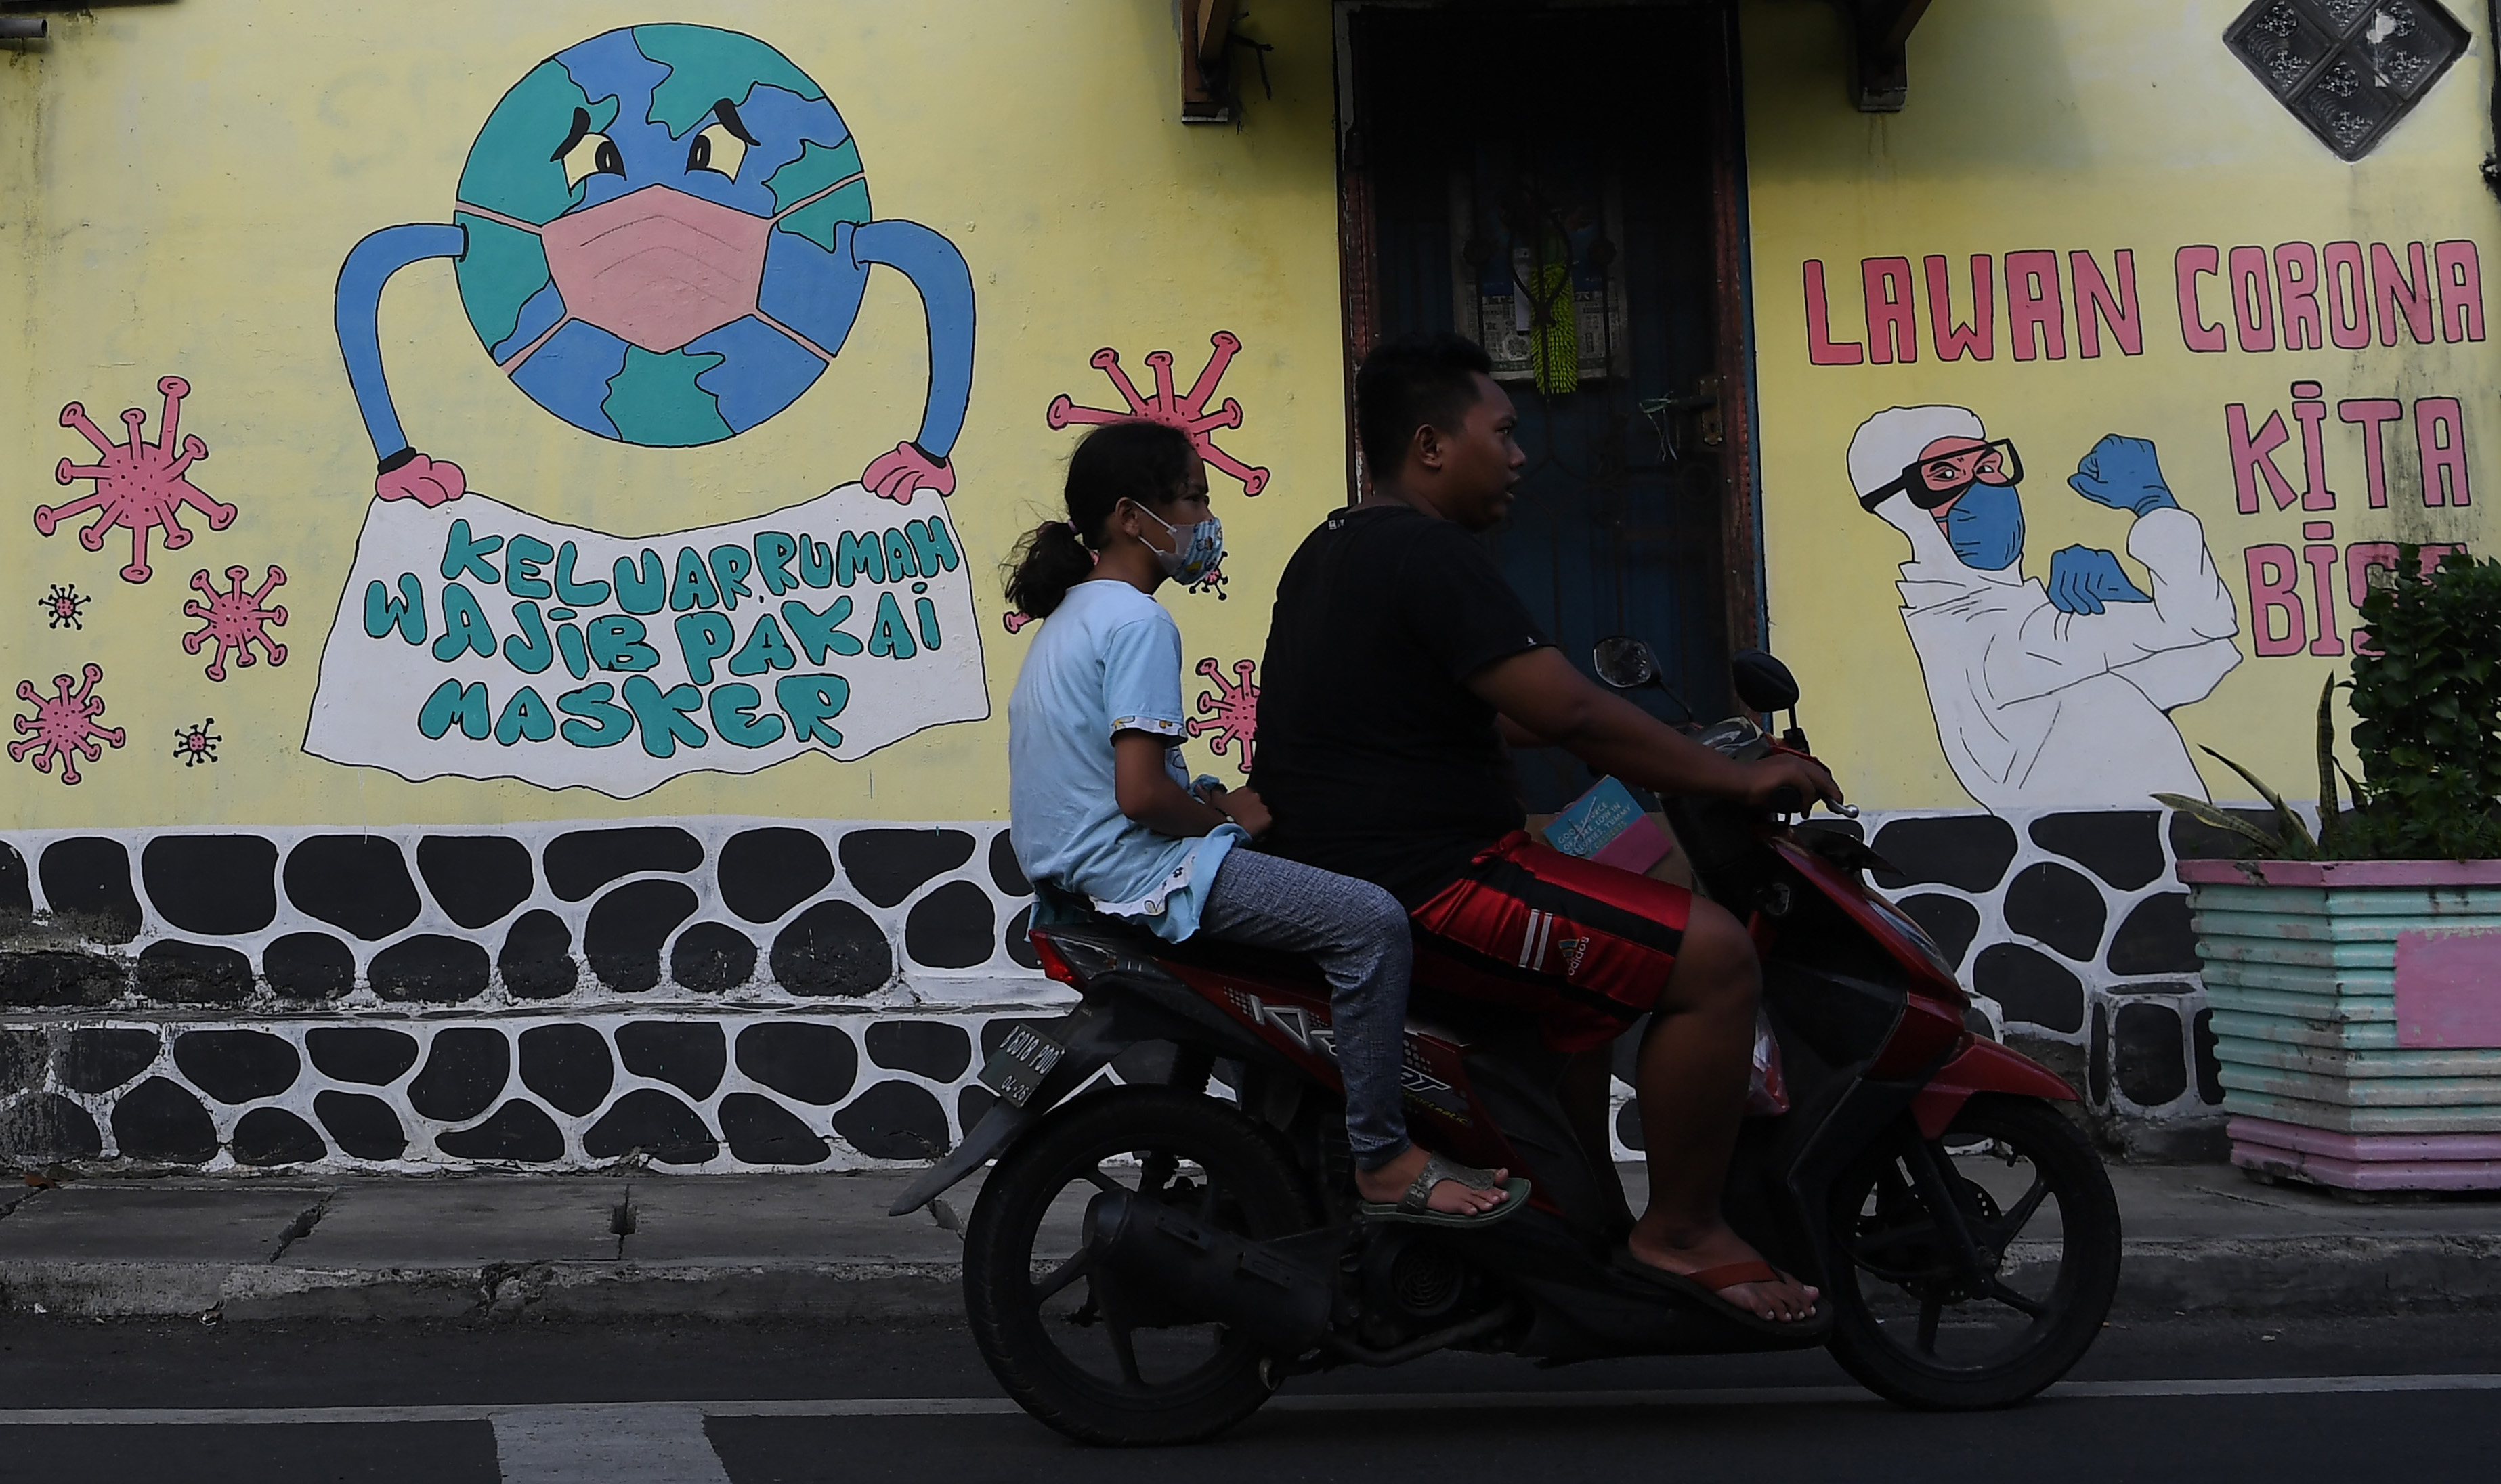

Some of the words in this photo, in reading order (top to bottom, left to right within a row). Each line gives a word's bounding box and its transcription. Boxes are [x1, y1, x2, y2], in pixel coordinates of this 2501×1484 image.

[1802, 248, 2143, 366] LAWAN
[2175, 240, 2486, 353] CORONA
[441, 518, 753, 614] KELUAR
[753, 515, 960, 596] RUMAH
[417, 674, 851, 759] MASKER
[1567, 936, 1590, 976] adidas
